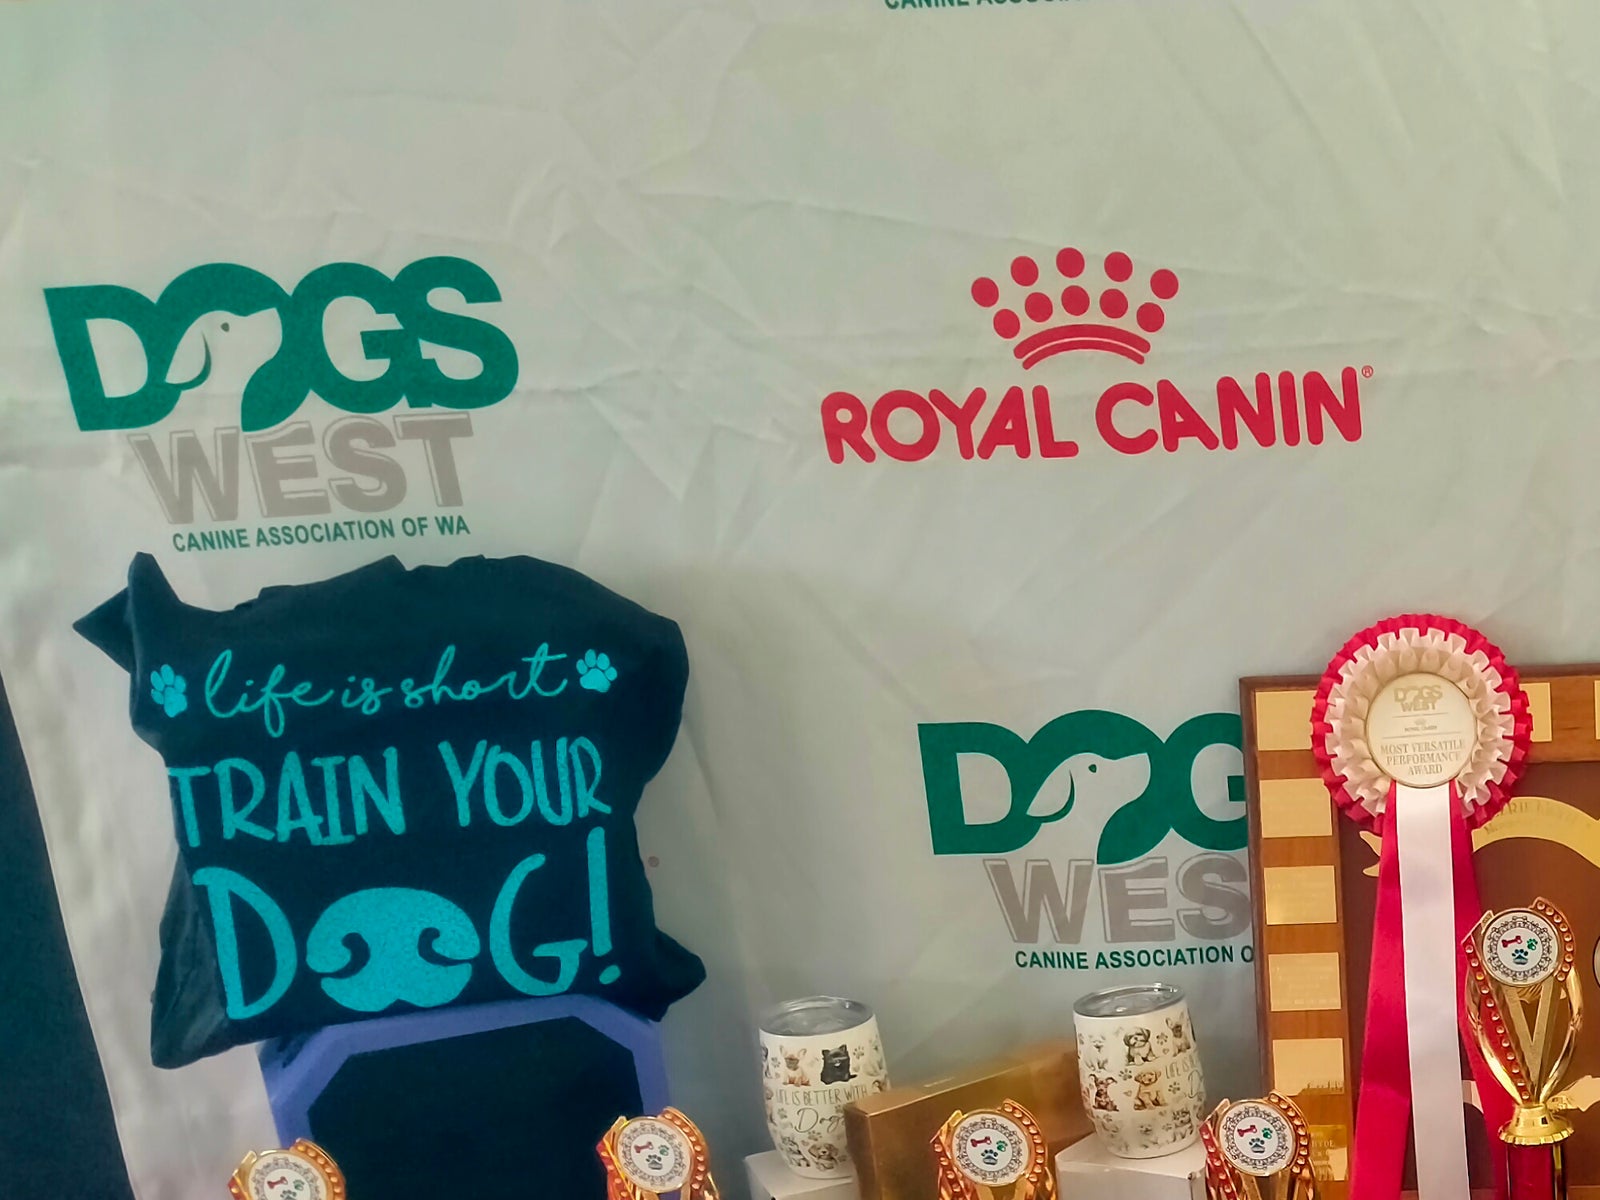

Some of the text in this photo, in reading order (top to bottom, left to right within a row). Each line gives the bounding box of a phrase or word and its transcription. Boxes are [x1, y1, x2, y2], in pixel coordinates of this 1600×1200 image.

[42, 255, 519, 432] DOGS
[820, 384, 1079, 464] ROYAL
[127, 411, 474, 524] WEST
[172, 514, 470, 552] CANINE ASSOCIATION OF WA
[204, 643, 567, 737] life is short
[1401, 701, 1436, 712] WEST
[1381, 739, 1466, 755] MOST VERSATILE
[1386, 751, 1460, 766] PERFORMANCE
[917, 709, 1247, 865] DOG
[1408, 764, 1443, 776] AWARD
[167, 736, 612, 847] TRAIN YOUR
[983, 851, 1250, 944] WES
[1014, 945, 1254, 970] CANINE ASSOCIATION O
[803, 1088, 841, 1106] BETTER
[843, 1085, 868, 1101] WITH
[794, 1107, 844, 1133] Dog
